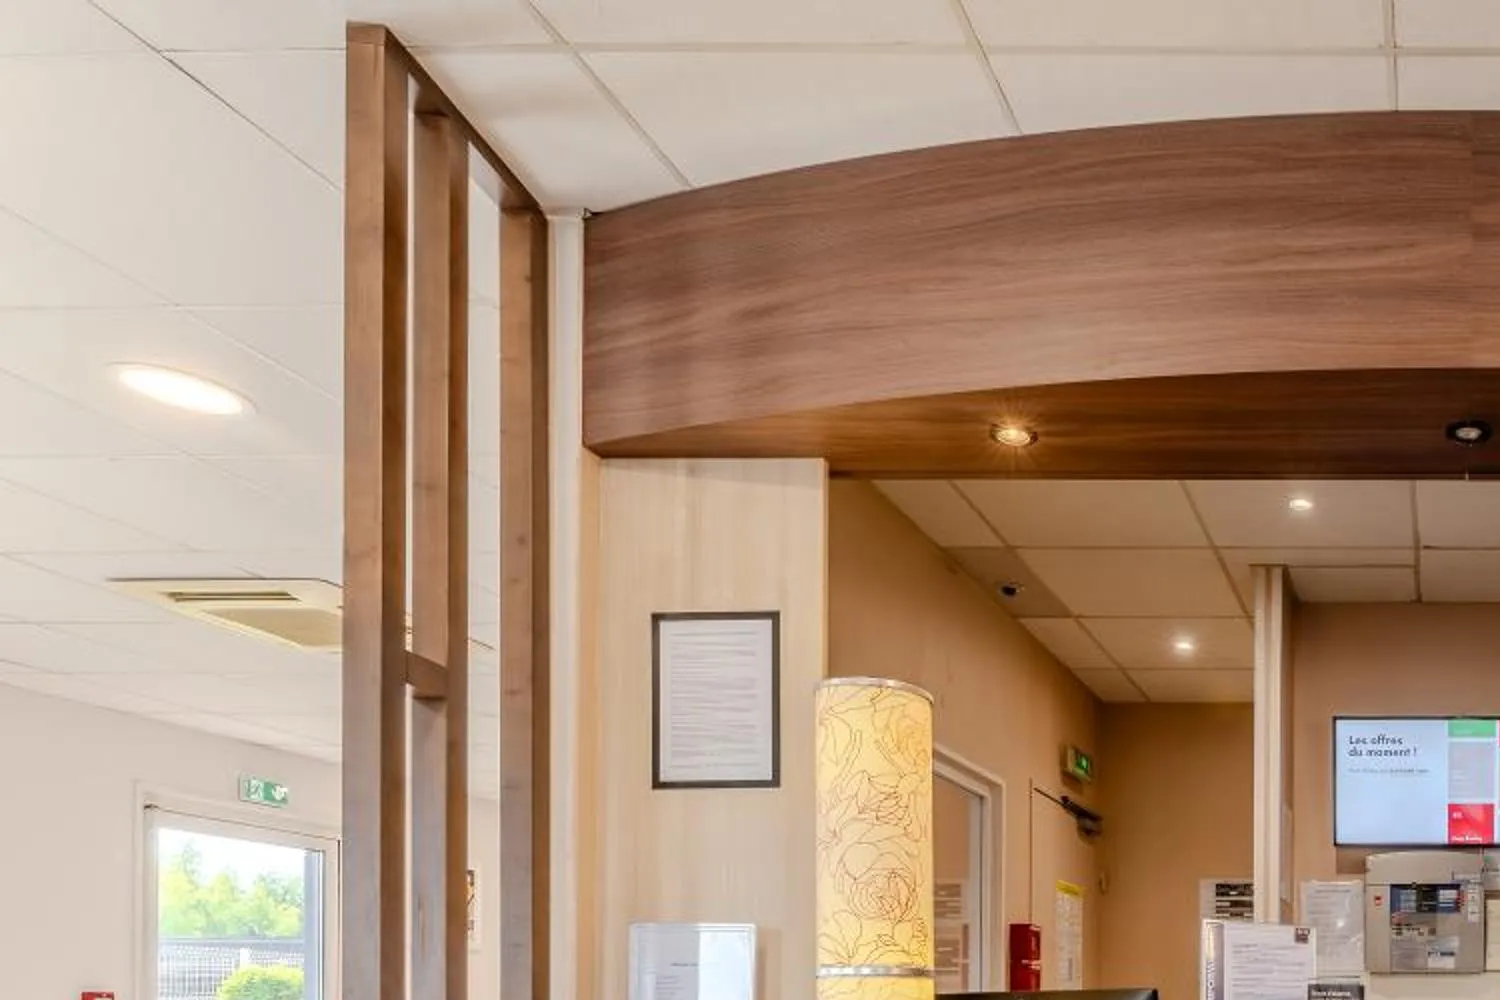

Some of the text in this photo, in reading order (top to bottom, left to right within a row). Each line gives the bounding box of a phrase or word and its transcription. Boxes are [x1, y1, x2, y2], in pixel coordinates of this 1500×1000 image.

[1348, 733, 1404, 745] Les offres
[1348, 746, 1363, 757] du
[1367, 747, 1411, 757] moment
